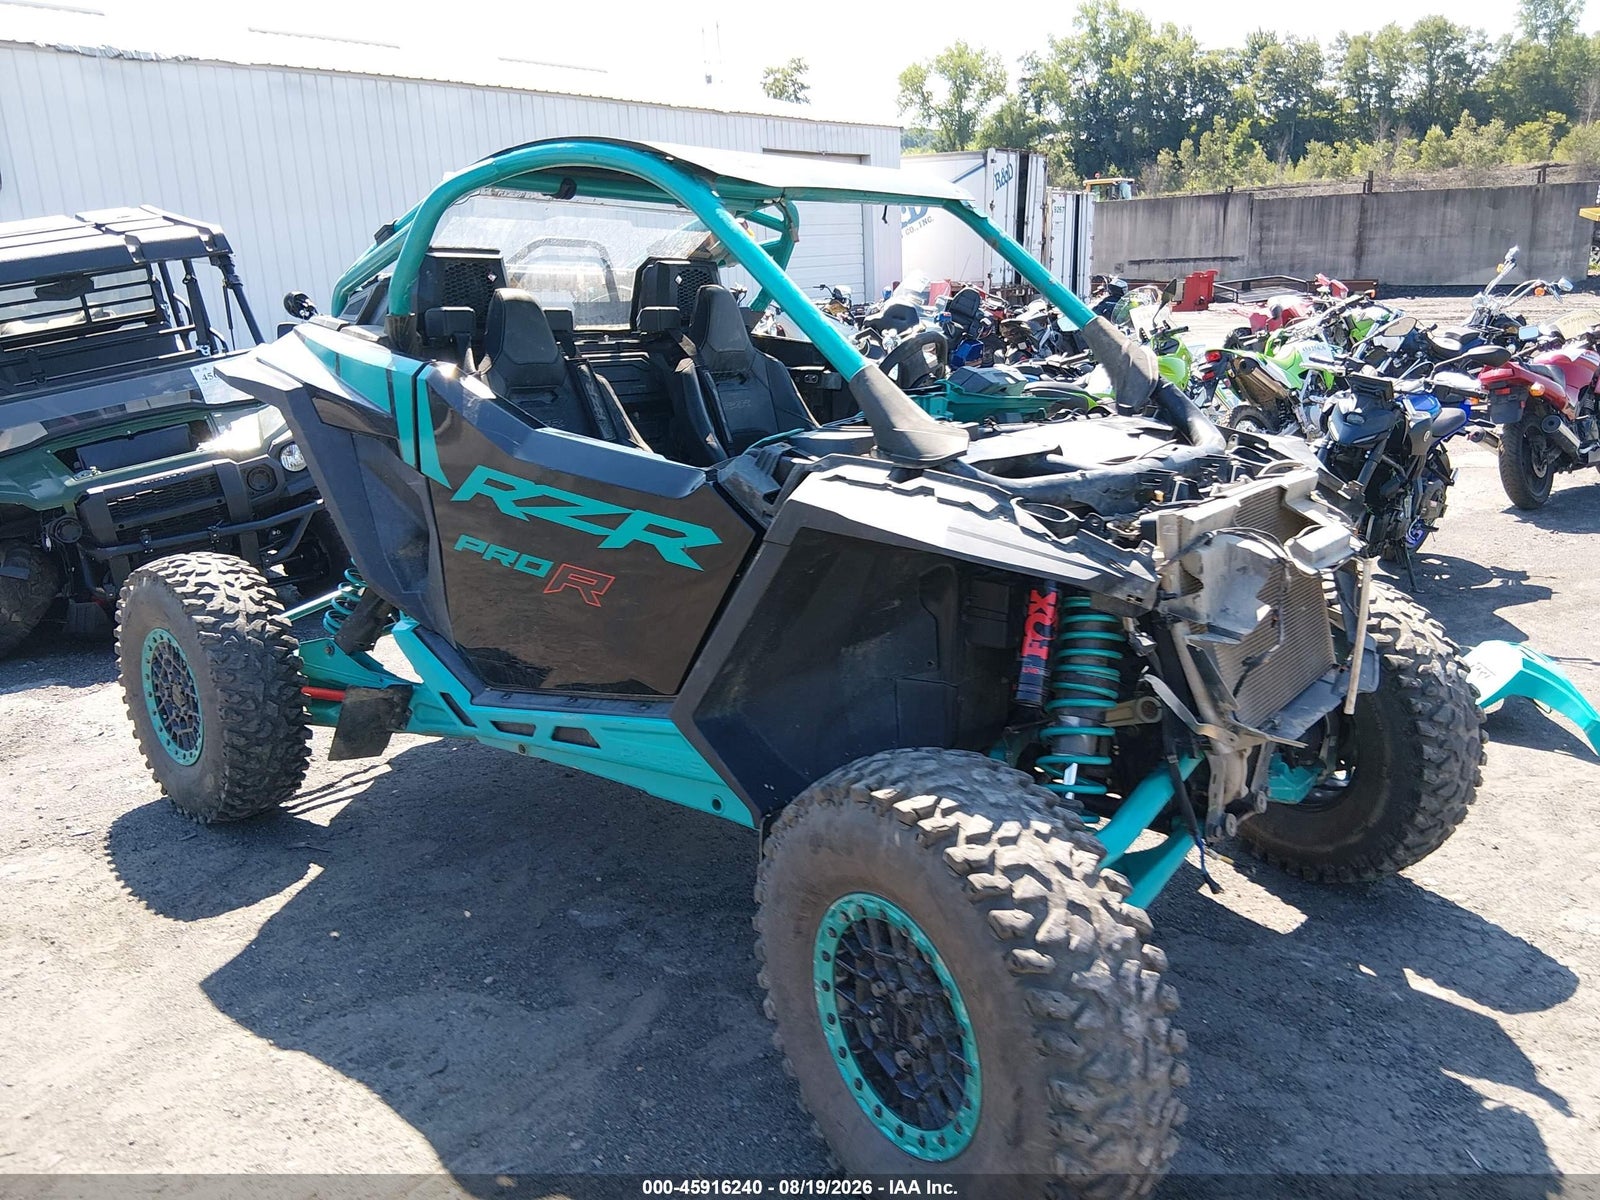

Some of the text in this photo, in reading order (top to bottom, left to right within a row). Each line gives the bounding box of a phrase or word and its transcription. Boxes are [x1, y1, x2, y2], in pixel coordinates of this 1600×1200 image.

[995, 162, 1013, 191] R&D
[451, 465, 723, 572] RZR
[454, 534, 616, 608] PRO R
[1021, 589, 1057, 660] FOX
